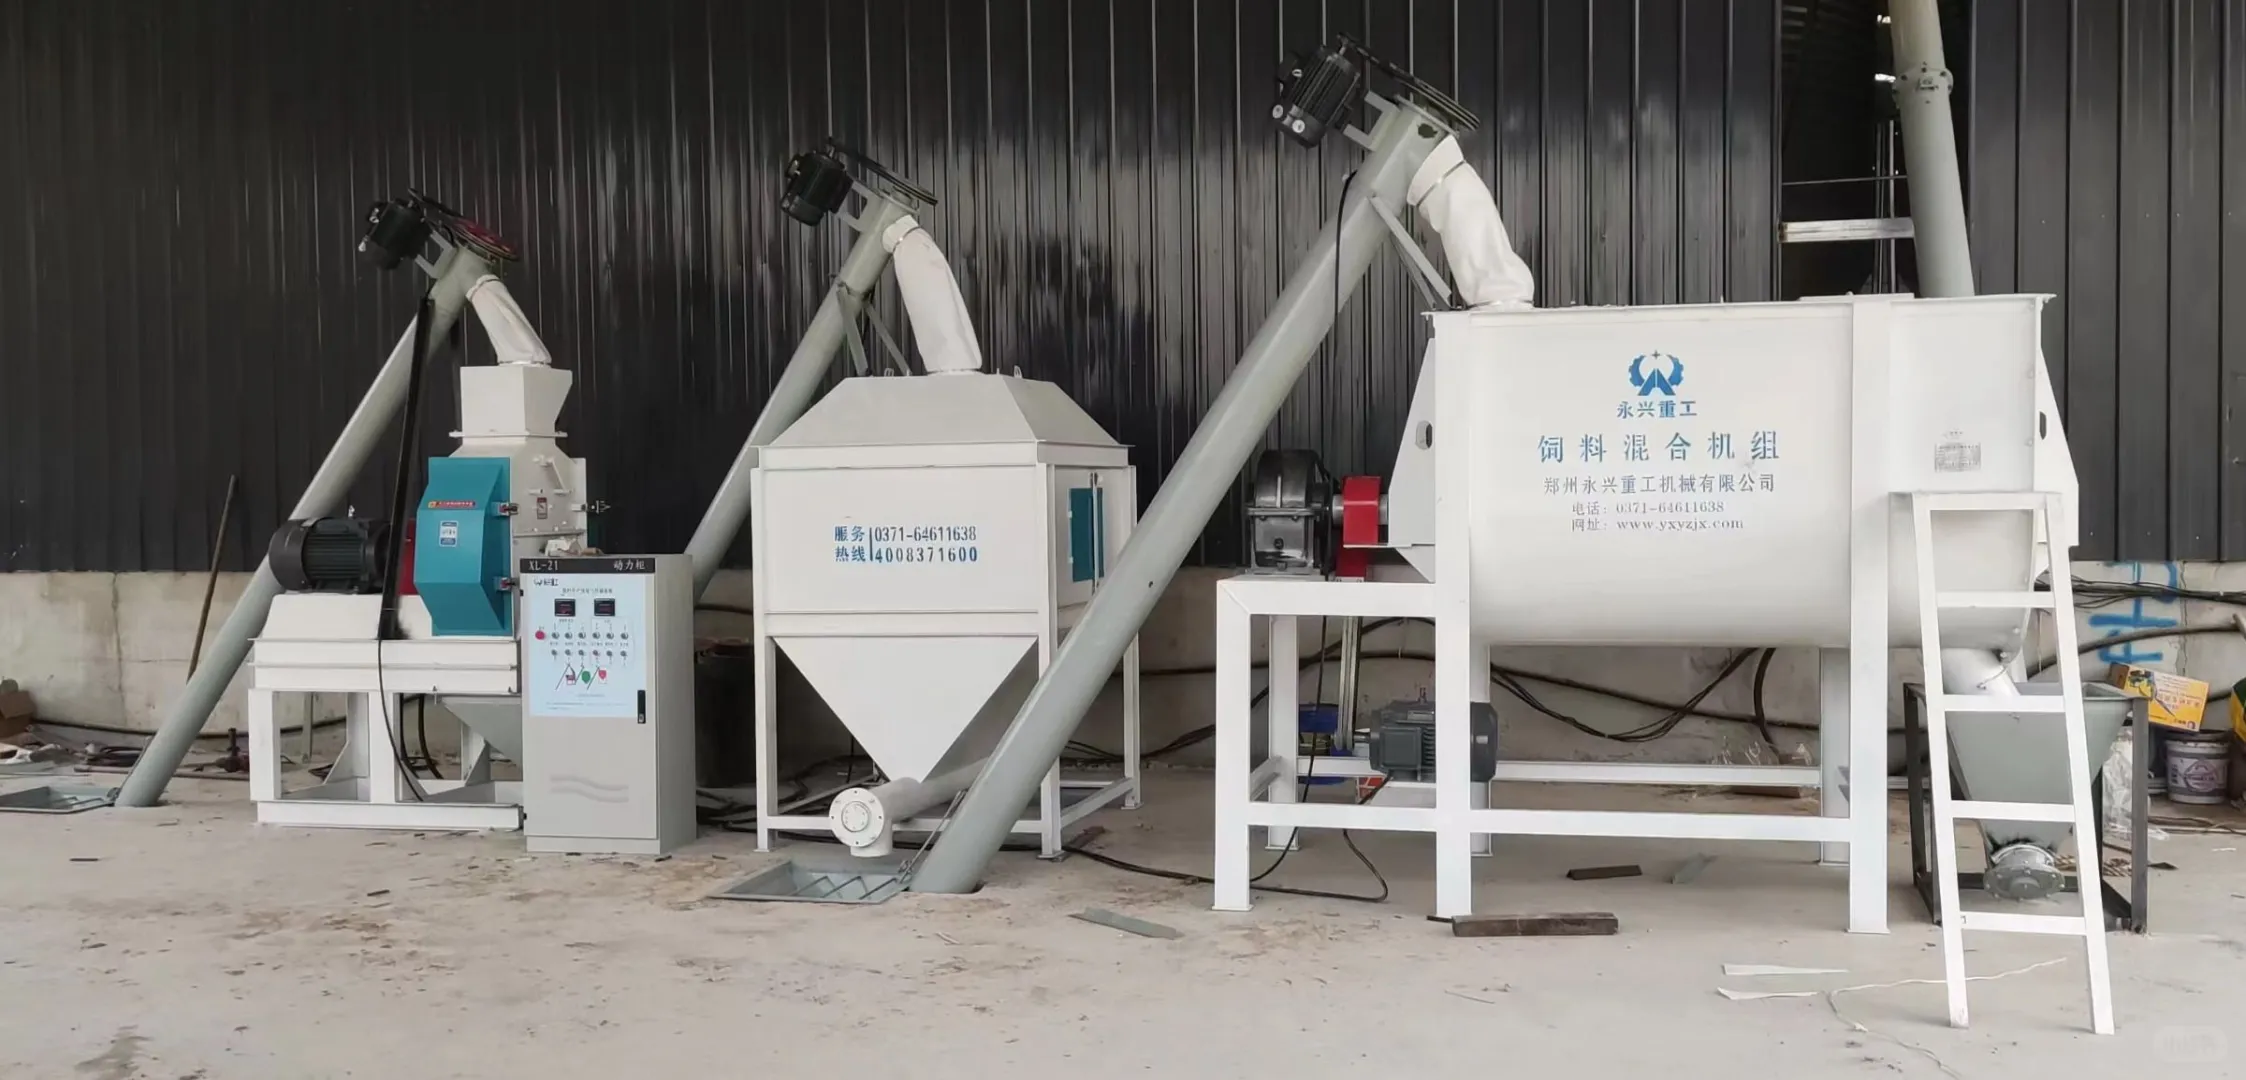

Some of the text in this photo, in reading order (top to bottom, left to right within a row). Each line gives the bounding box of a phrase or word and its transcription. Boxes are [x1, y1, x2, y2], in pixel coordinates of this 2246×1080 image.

[1616, 400, 1698, 419] 永兴重工
[1537, 430, 1780, 463] 饲料混合机组
[1544, 473, 1775, 495] 郑州永兴重工机械有限公司
[834, 525, 977, 542] 服务 0371-64611638
[834, 545, 978, 563] 热线 4008371600
[528, 560, 559, 571] XL-21
[613, 560, 646, 571] 动力柜
